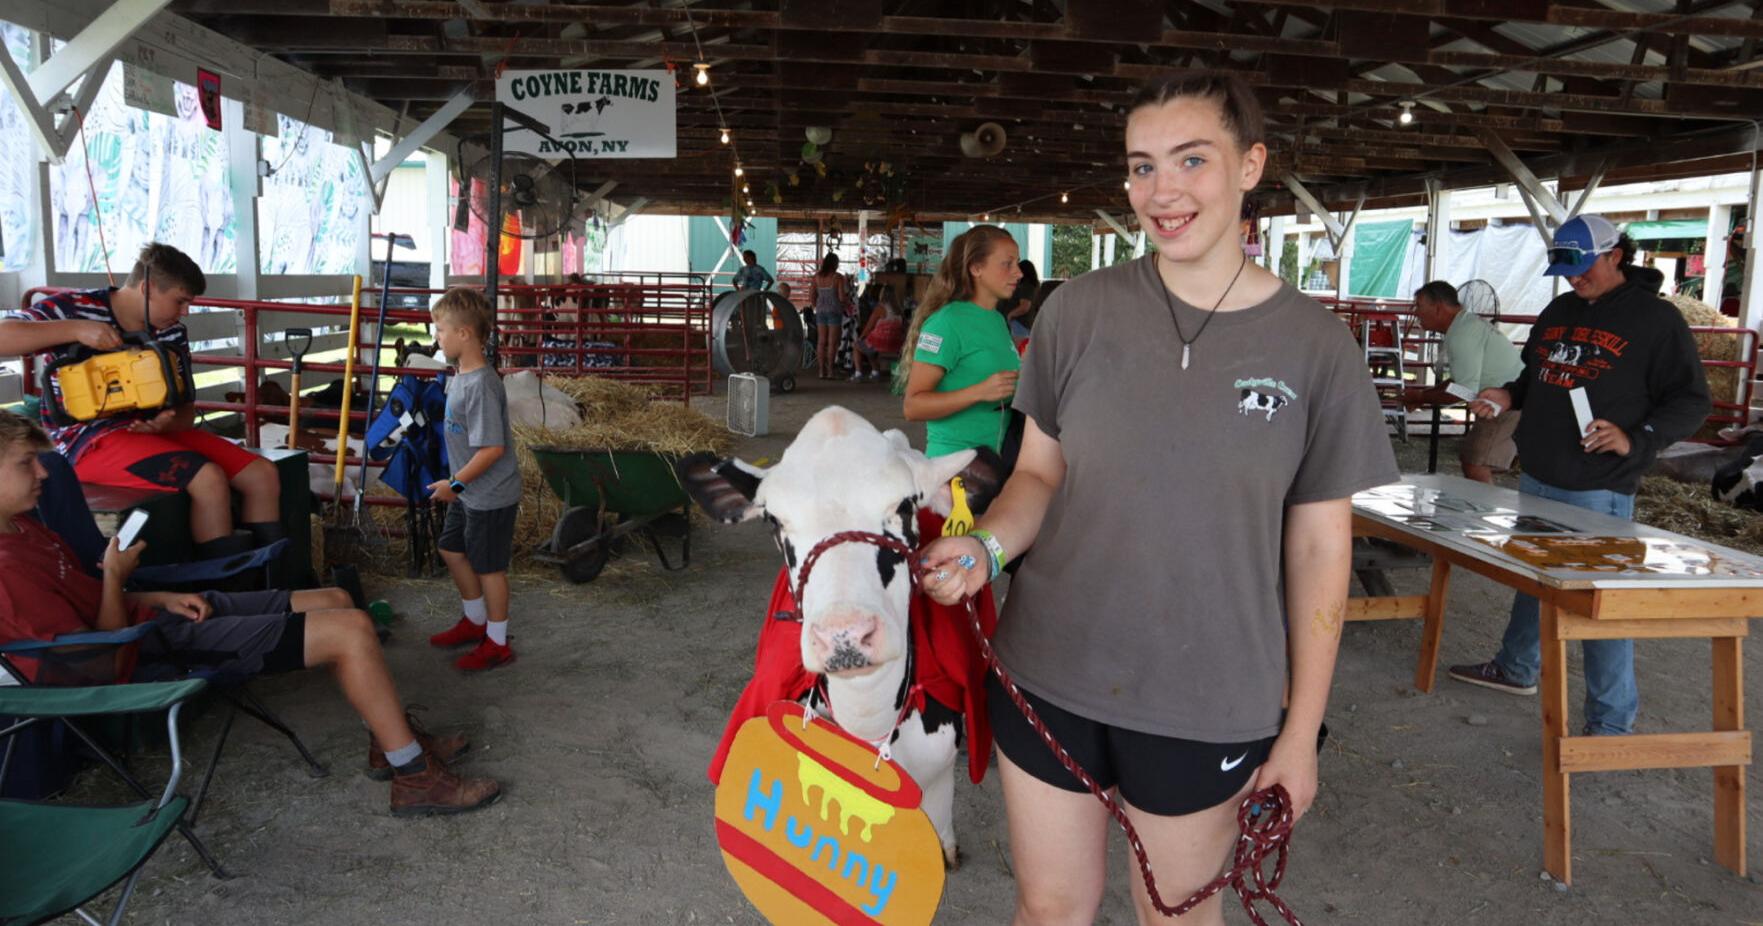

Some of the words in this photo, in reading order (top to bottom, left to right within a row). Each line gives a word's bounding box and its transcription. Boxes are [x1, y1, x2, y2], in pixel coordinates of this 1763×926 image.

[511, 71, 582, 100] COYNE
[587, 72, 660, 102] FARMS
[601, 140, 629, 153] NY
[946, 520, 973, 536] 10
[743, 768, 897, 916] Hunny
